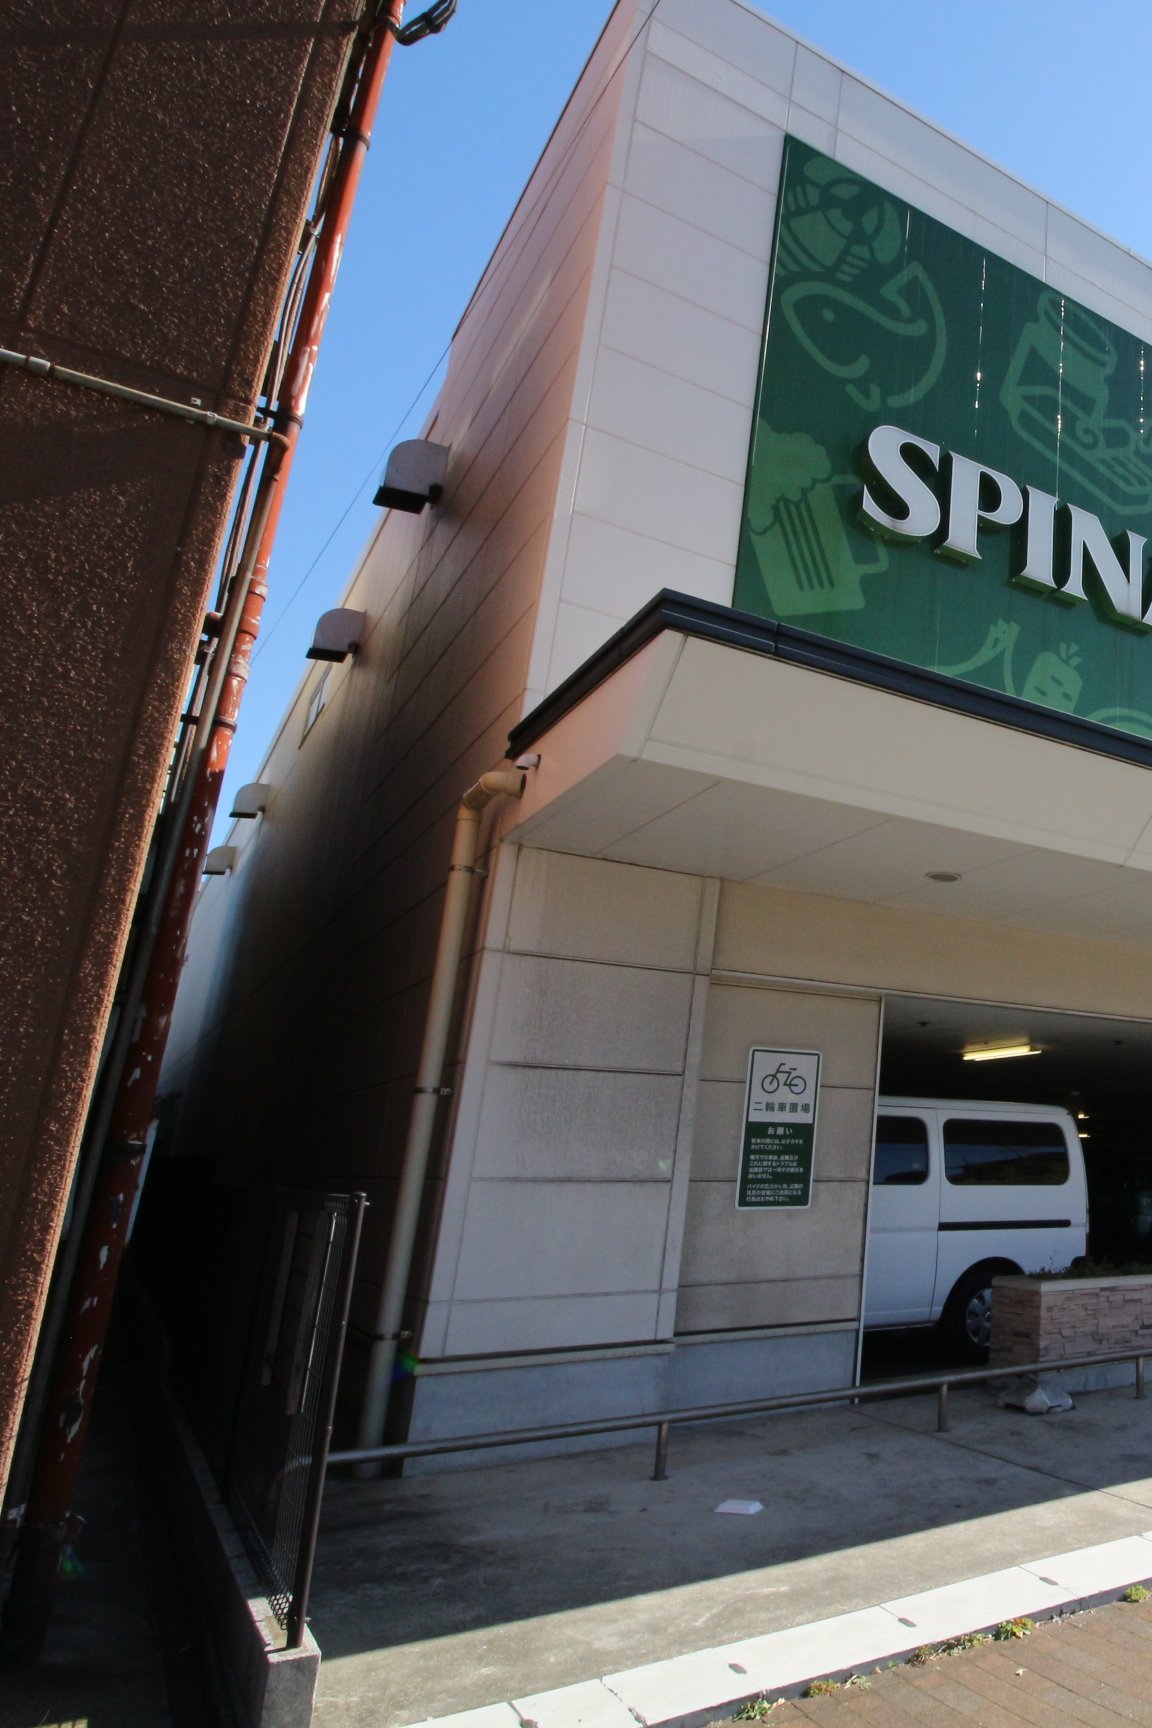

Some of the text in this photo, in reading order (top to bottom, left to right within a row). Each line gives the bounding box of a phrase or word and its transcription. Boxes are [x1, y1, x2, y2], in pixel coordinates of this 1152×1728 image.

[753, 1102, 811, 1113] 二輪車置場
